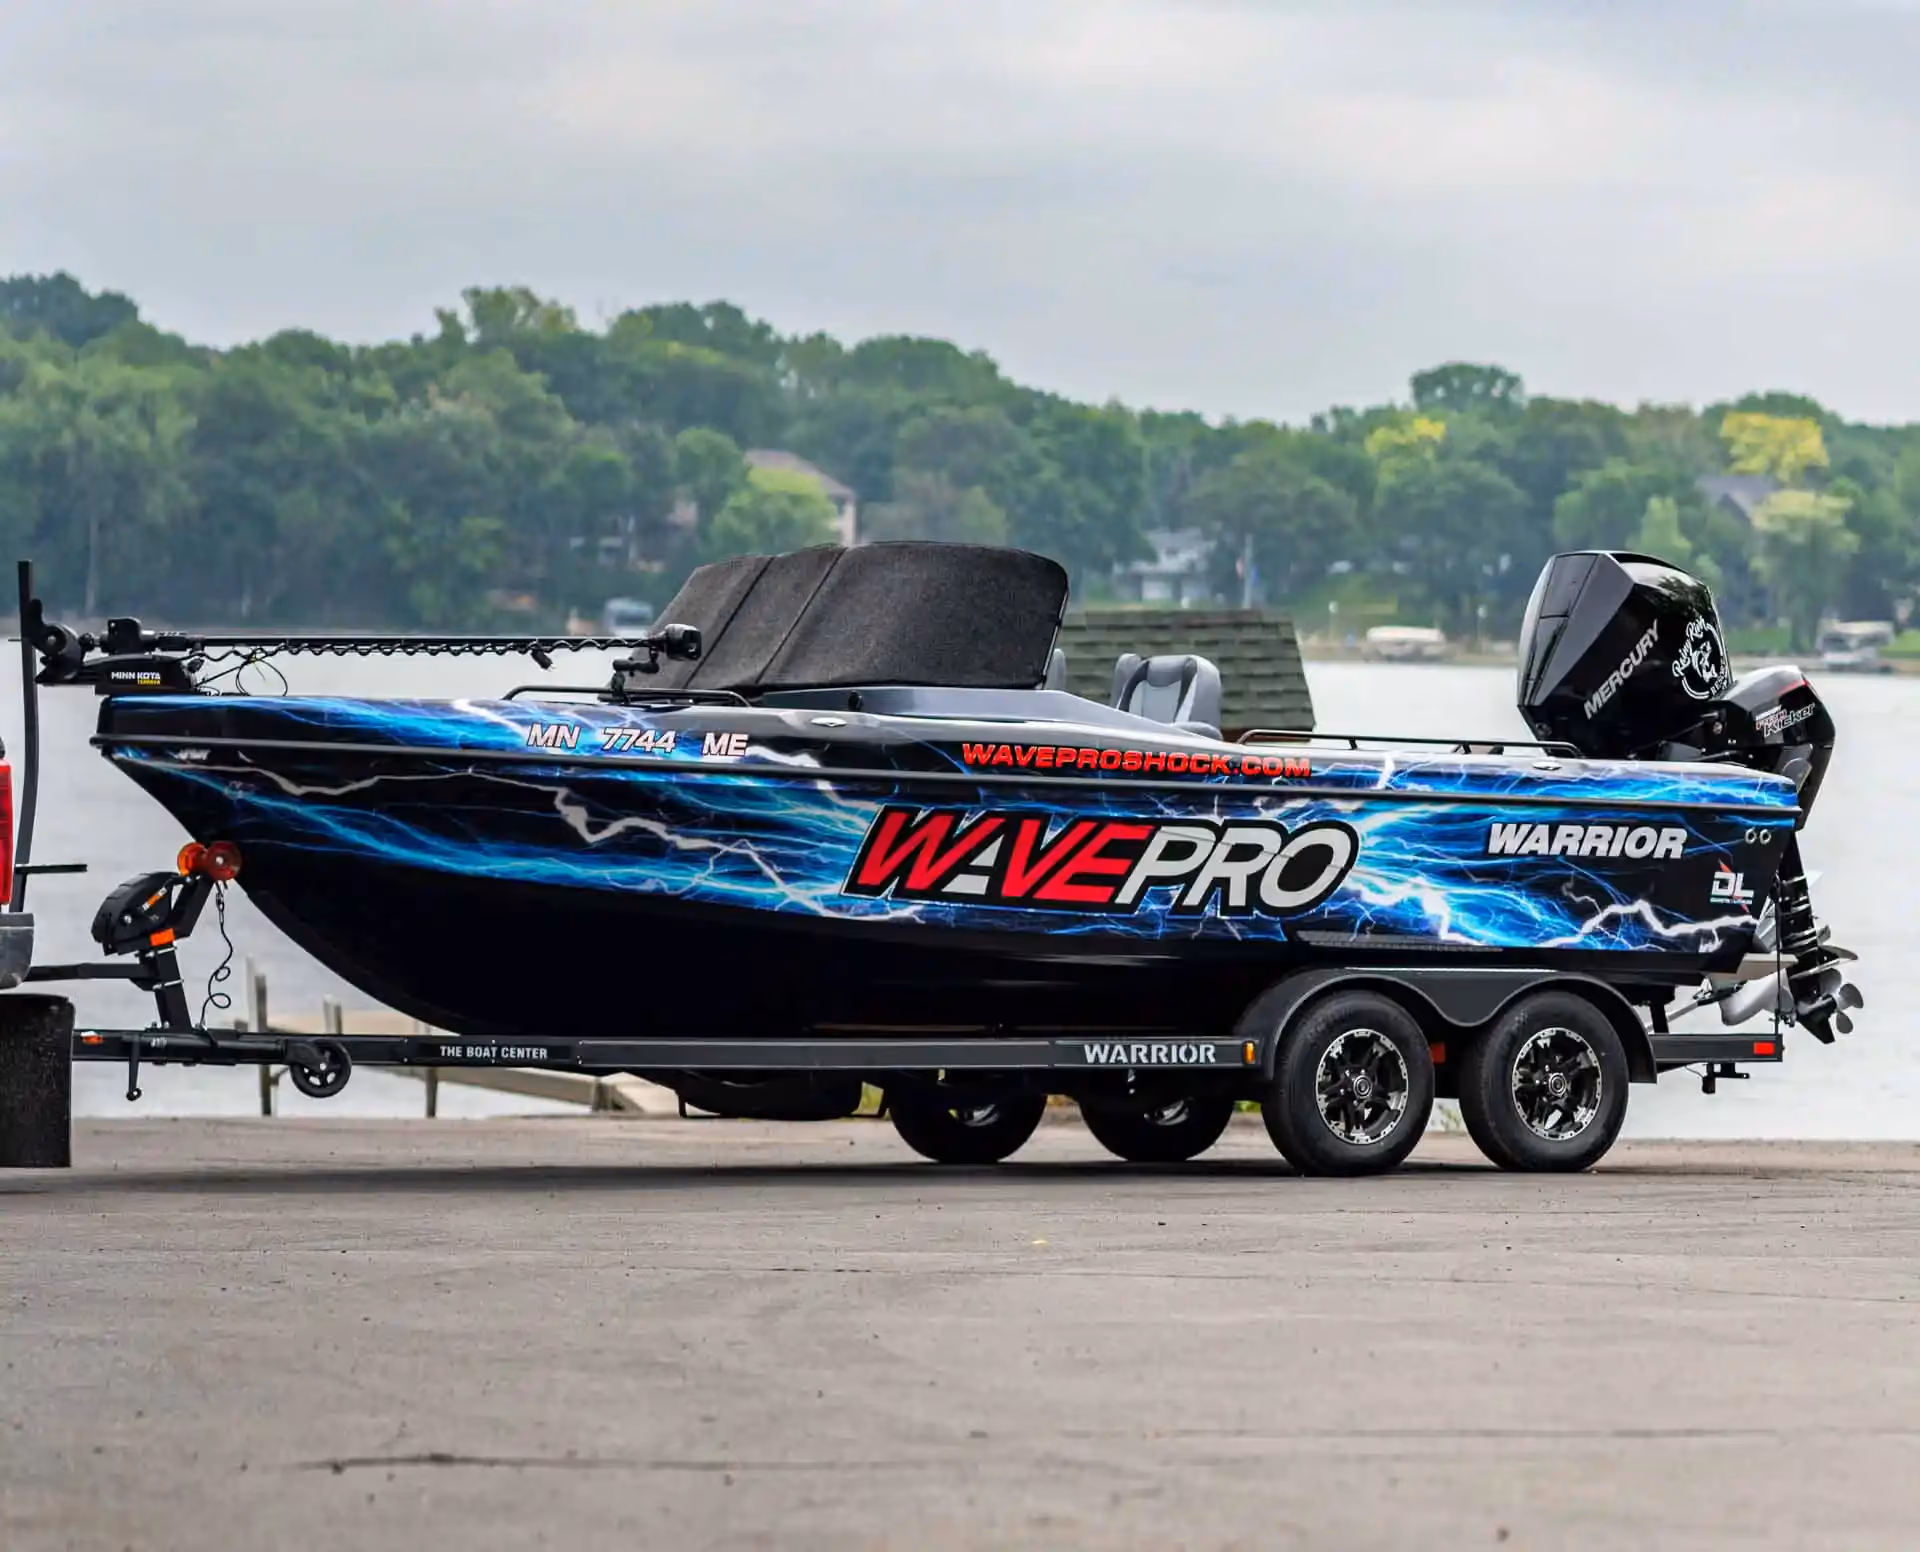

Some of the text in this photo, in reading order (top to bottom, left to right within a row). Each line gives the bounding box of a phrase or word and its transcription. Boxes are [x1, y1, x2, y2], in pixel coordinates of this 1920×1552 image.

[111, 671, 161, 680] MINN KOTA
[1583, 618, 1658, 720] MERCURY
[528, 722, 749, 757] MN 7744 ME
[962, 742, 1313, 778] WAVEPROSHOCK.COM
[1487, 823, 1688, 860] WARRIOR
[440, 1045, 548, 1059] THE BOAT CENTER
[1084, 1043, 1216, 1064] WARRIOR
